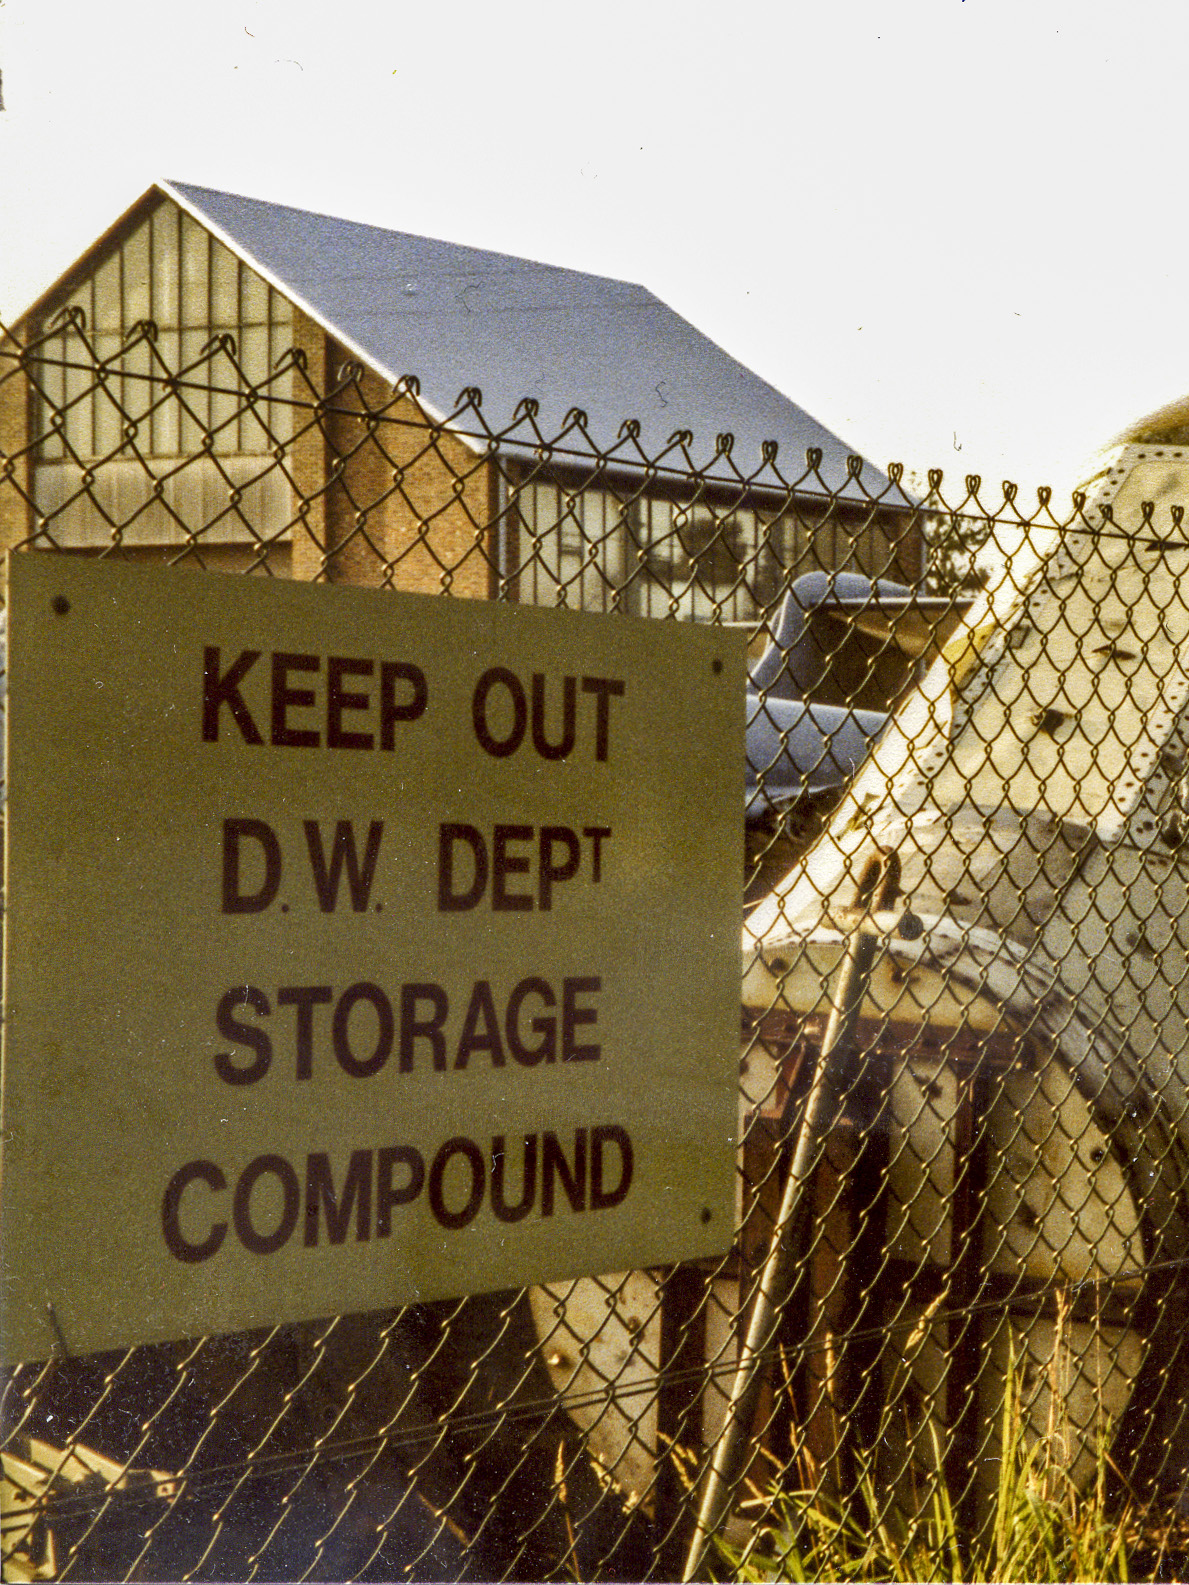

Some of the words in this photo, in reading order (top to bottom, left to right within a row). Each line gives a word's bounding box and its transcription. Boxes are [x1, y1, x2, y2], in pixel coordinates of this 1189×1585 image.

[202, 645, 428, 753] KEEP
[470, 664, 625, 763] OUT
[436, 821, 612, 912] DEPT
[213, 976, 602, 1086] STORAGE
[161, 1124, 635, 1263] COMPOUND
